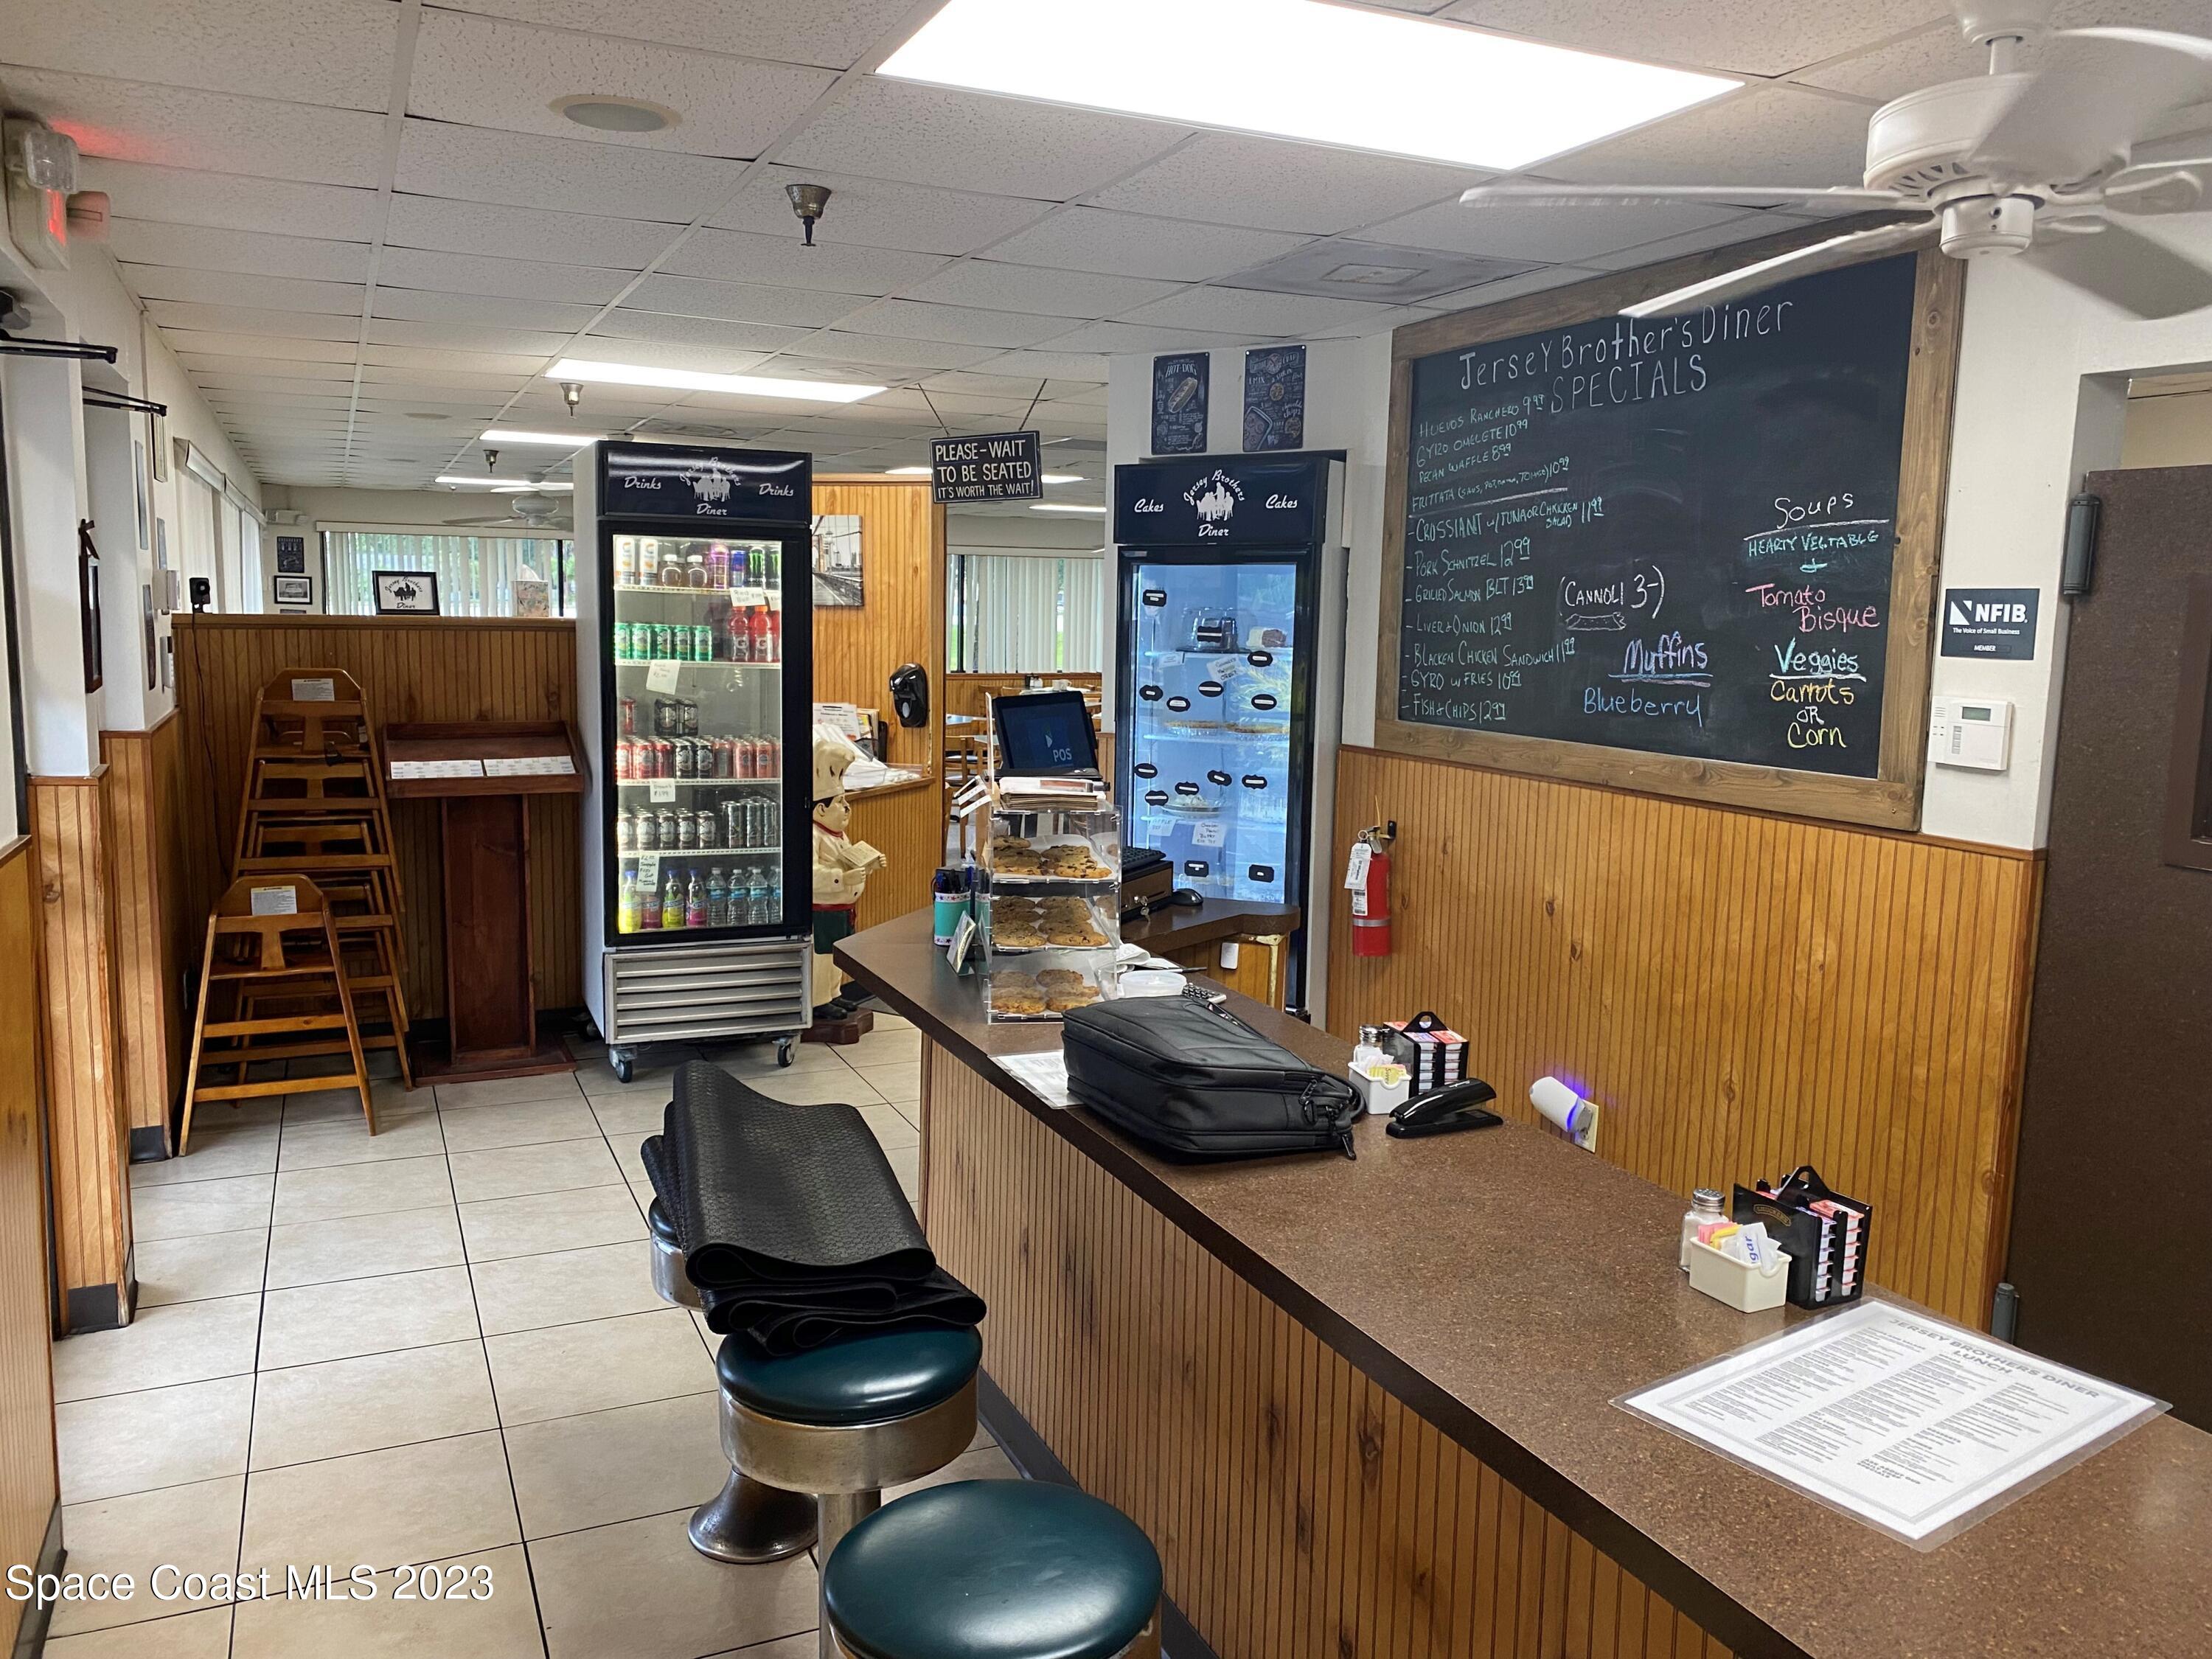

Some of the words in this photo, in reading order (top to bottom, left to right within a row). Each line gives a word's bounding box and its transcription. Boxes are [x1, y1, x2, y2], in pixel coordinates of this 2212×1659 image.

[1701, 301, 1794, 344] Diner
[1549, 354, 1708, 414] SPECIALS
[988, 439, 1026, 459] WAIT
[625, 476, 661, 490] Drinks
[937, 466, 956, 483] TO
[961, 465, 978, 481] BE
[982, 461, 1032, 481] SEATED
[759, 483, 794, 497] Drinks
[938, 485, 954, 498] IT'S
[956, 484, 985, 497] WORTH
[987, 483, 1004, 495] THE
[1005, 479, 1034, 495] WAIT!
[1211, 469, 1245, 501] Brothers
[696, 503, 728, 515] Diner
[1133, 498, 1164, 513] Cakes
[1265, 493, 1298, 509] Cakes
[1412, 491, 1455, 512] FRITTATA
[1775, 493, 1854, 529] Soups
[1198, 524, 1229, 537] Diner
[1414, 551, 1439, 577] PORK
[1442, 549, 1497, 576] SCHNITZEL
[1486, 577, 1509, 600] BLT
[1745, 583, 1826, 608] Tomato
[1416, 613, 1443, 633] LIVER
[1792, 605, 1880, 633] Bisque
[1458, 640, 1498, 665] CHICKEN
[1503, 644, 1555, 667] SANDWICH
[1623, 630, 1708, 675] Muffins
[1774, 637, 1859, 674] Veggies
[1411, 669, 1444, 690] GYRO
[1464, 672, 1493, 686] FRIES
[1770, 678, 1855, 706] Carrots
[1585, 686, 1704, 728] Blueberry
[1787, 722, 1847, 748] Corn
[1053, 748, 1072, 762] POS
[1745, 1236, 1759, 1264] gar
[1889, 1318, 1950, 1343] JERSEY
[1949, 1340, 2043, 1377] BROTHERS
[2042, 1373, 2100, 1399] DINER
[1952, 1349, 2014, 1375] LUNCH
